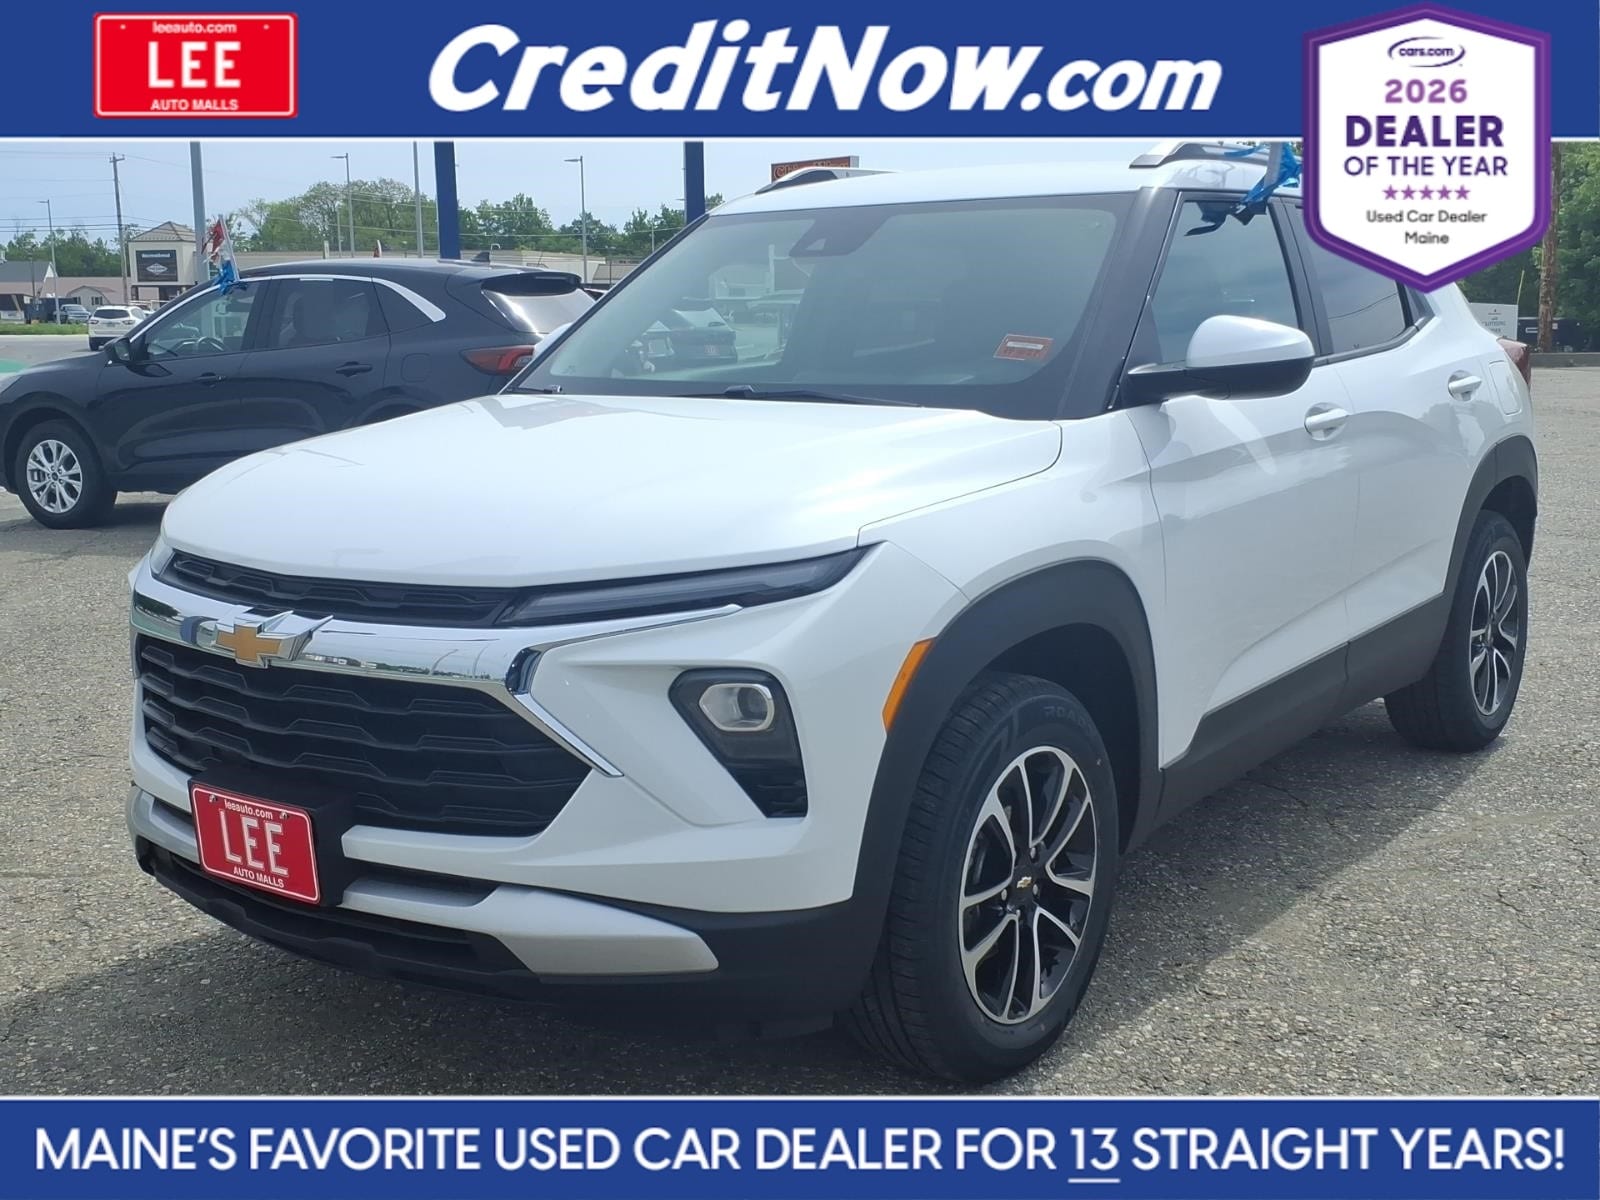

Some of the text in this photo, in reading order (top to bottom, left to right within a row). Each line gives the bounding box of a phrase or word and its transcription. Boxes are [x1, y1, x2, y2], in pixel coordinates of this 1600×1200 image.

[224, 799, 273, 819] leeauto.com
[219, 810, 288, 876] LEE
[233, 866, 285, 888] AUTO MALLS
